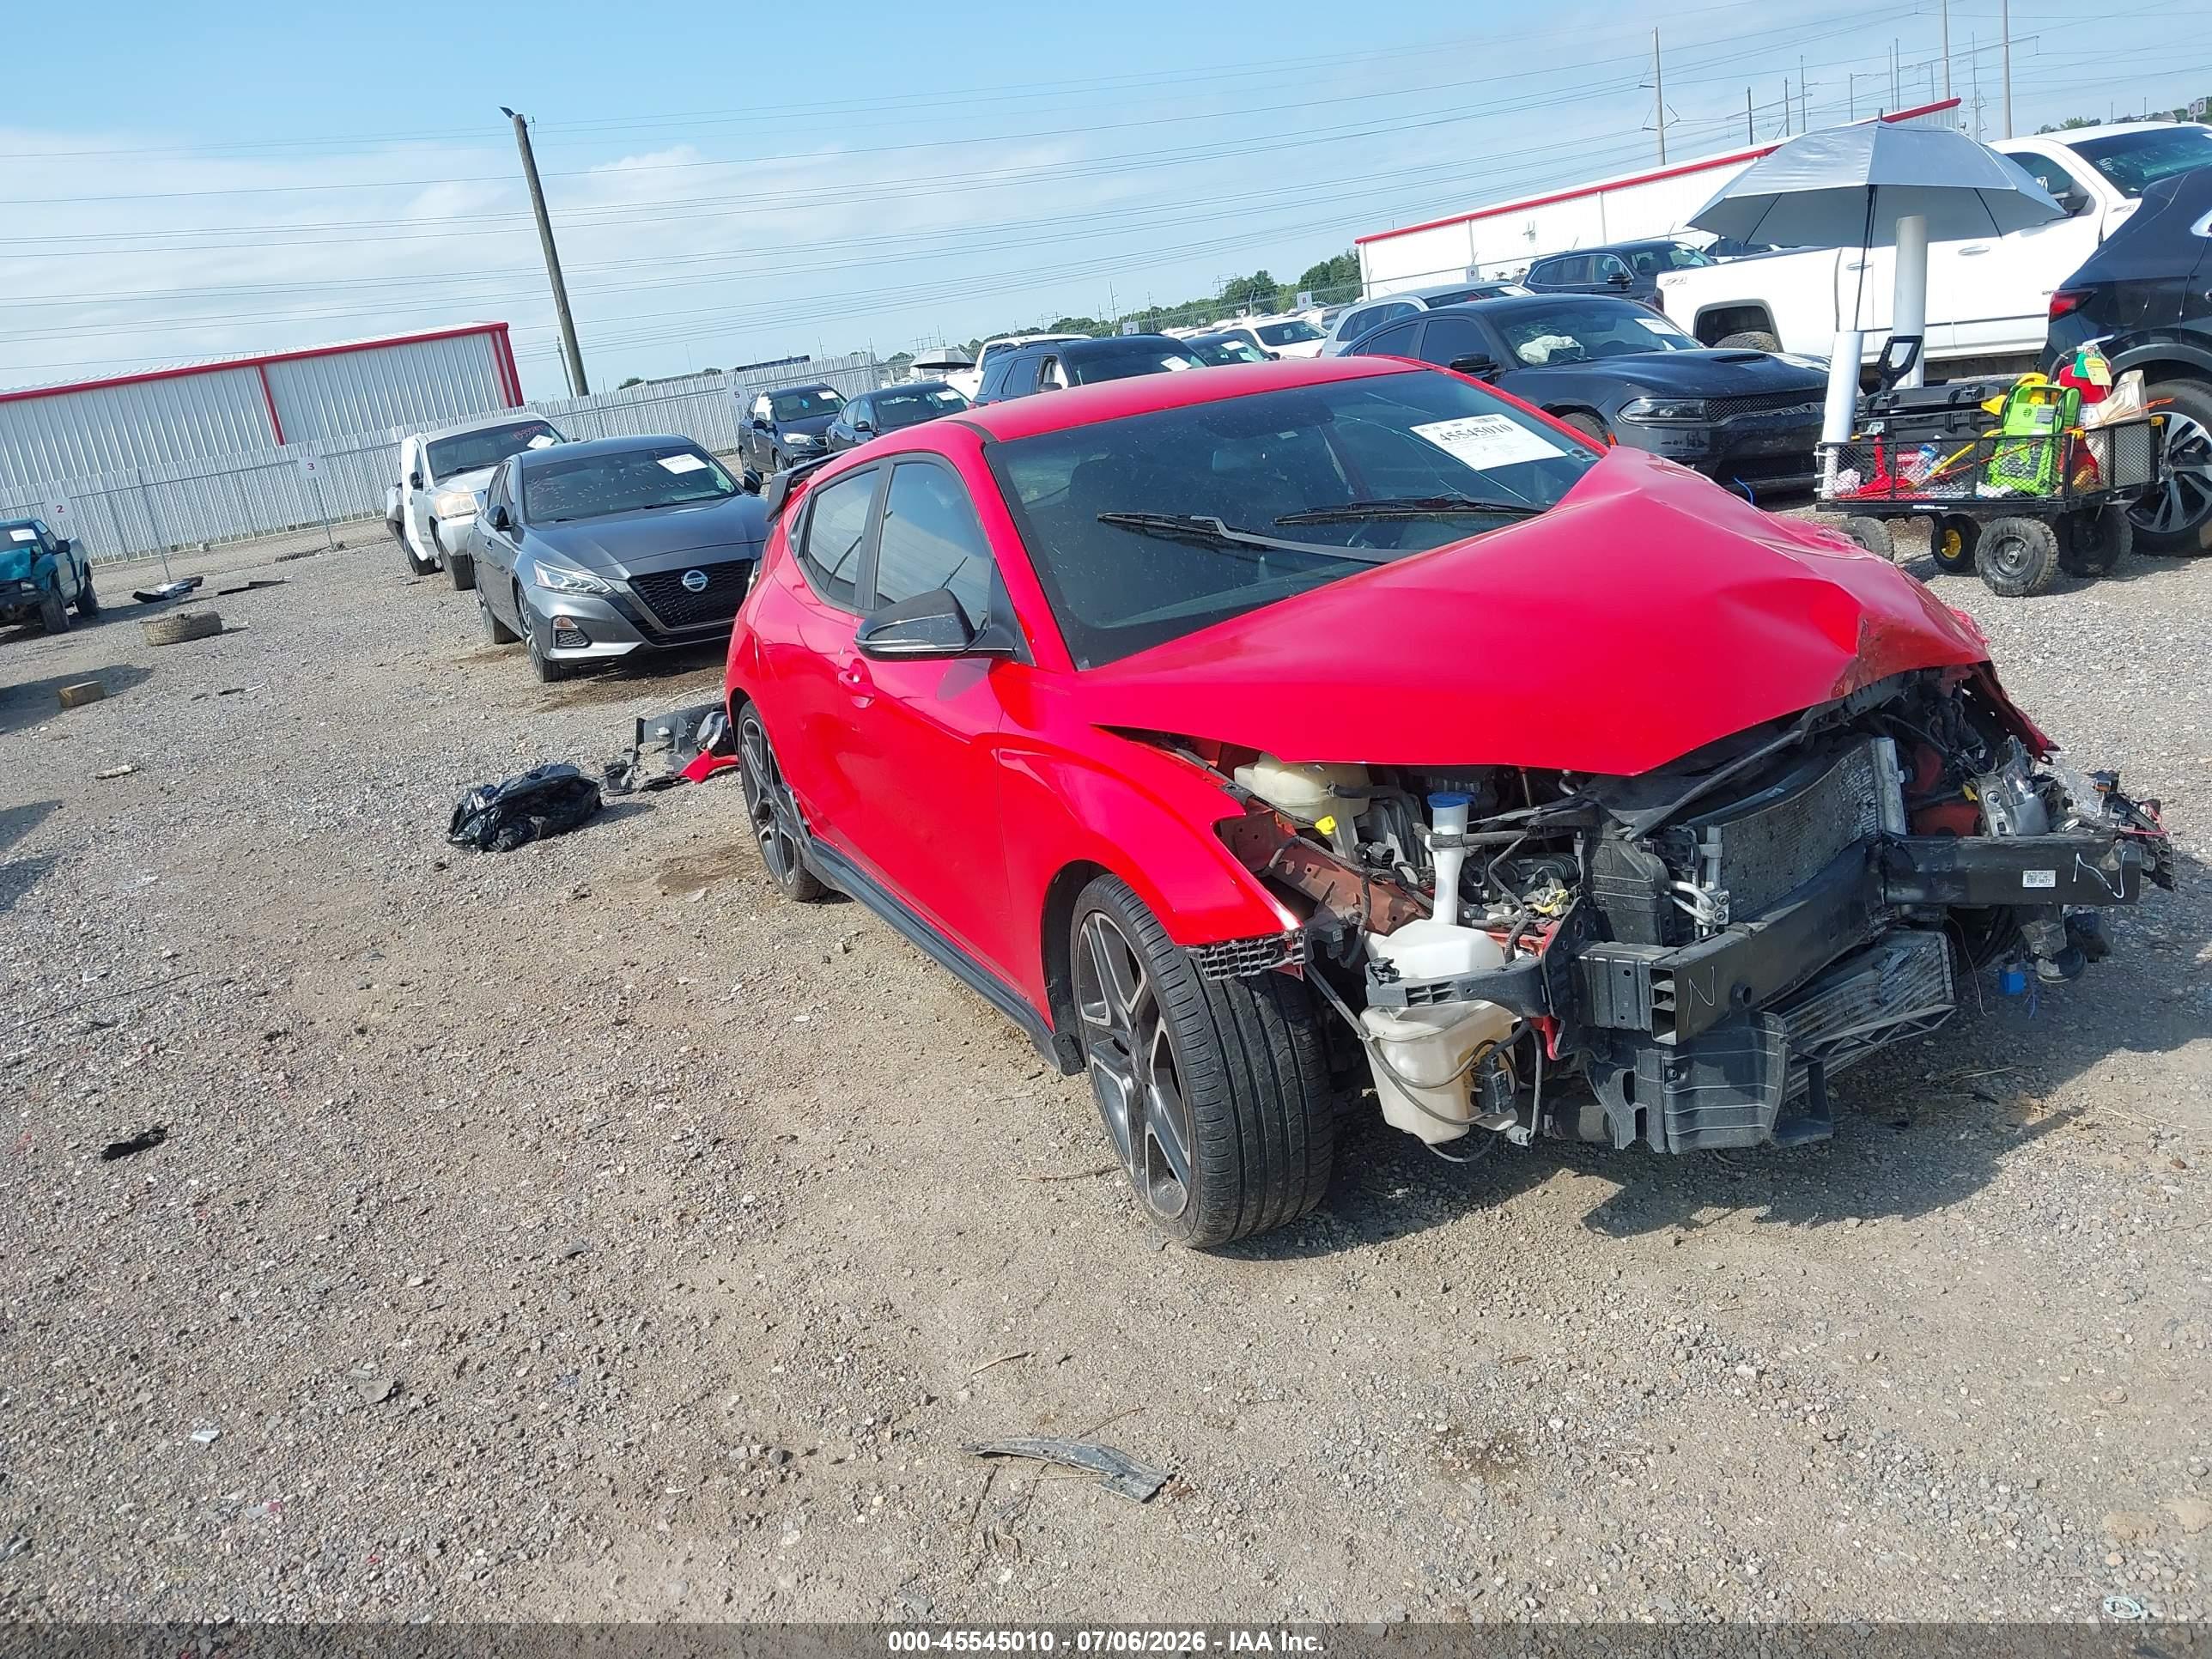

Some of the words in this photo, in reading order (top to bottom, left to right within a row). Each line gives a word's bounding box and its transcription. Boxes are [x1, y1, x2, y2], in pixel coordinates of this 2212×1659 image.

[1439, 423, 1513, 441] 45545010
[307, 462, 315, 471] 3
[56, 504, 65, 514] 2
